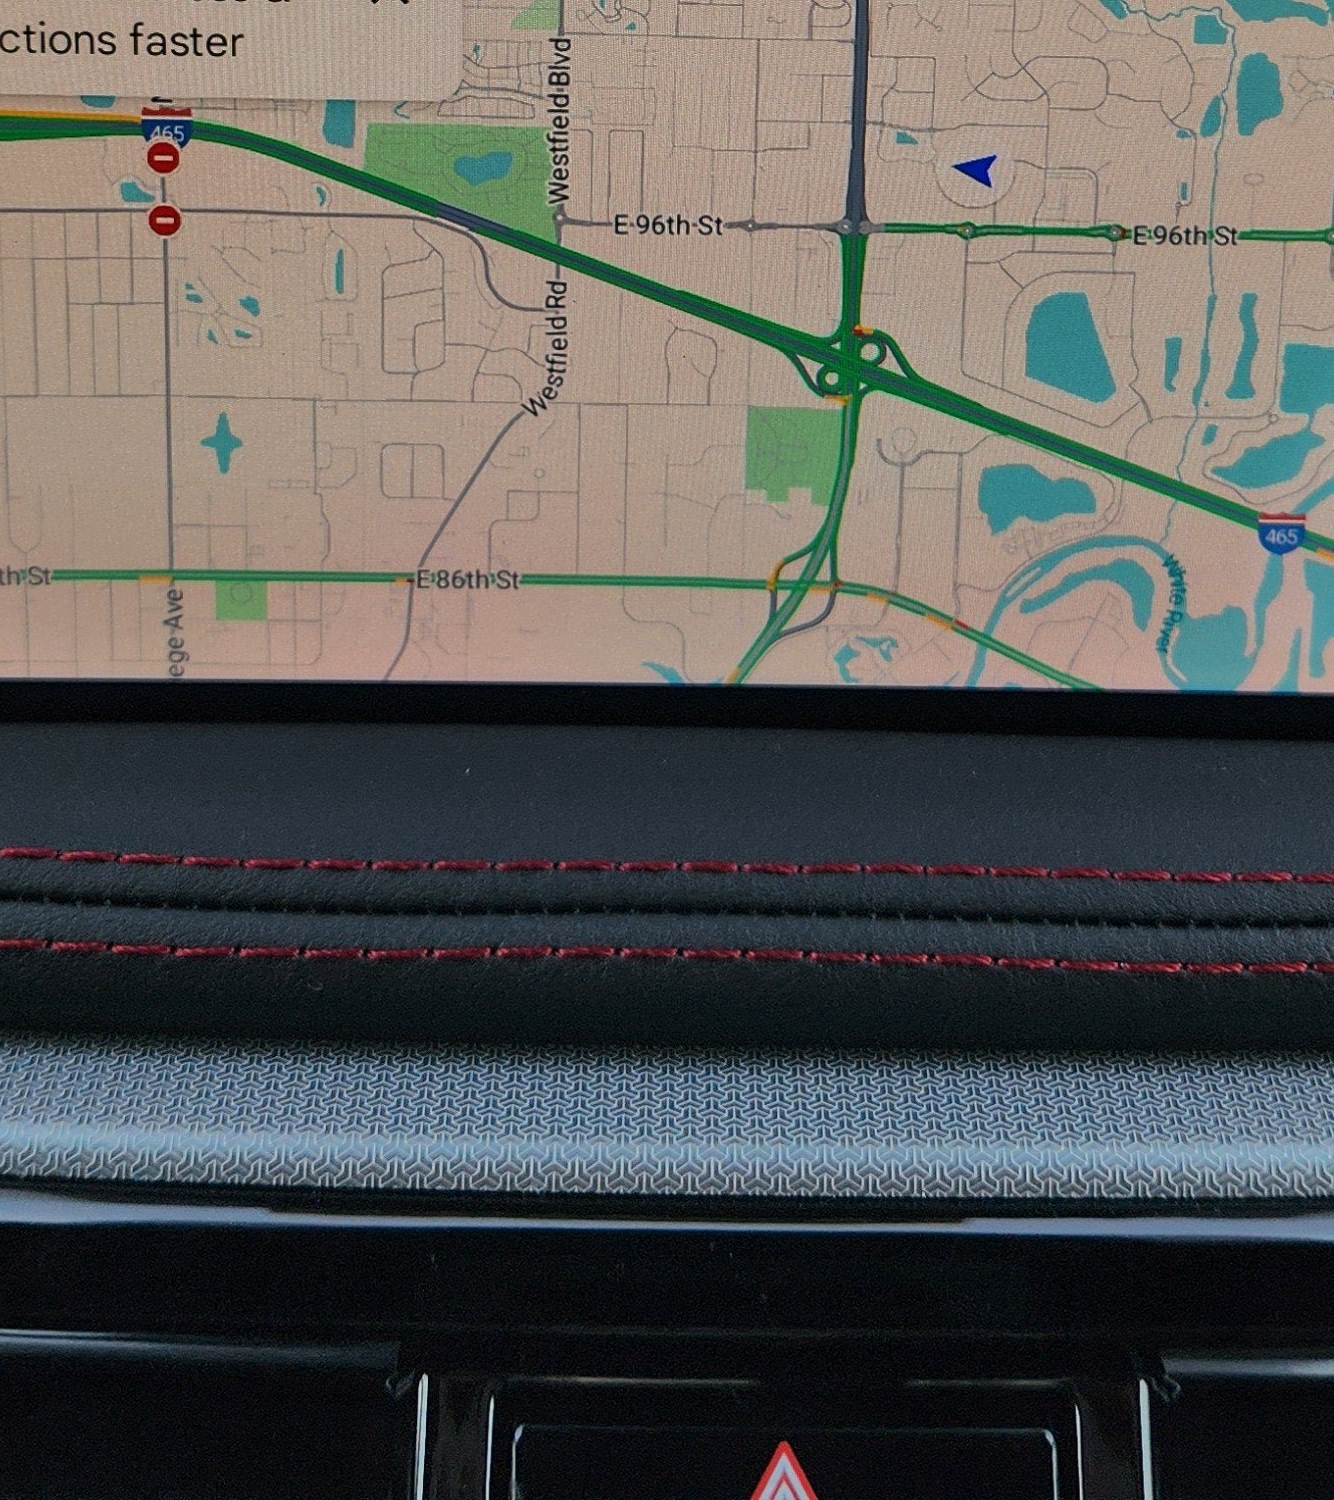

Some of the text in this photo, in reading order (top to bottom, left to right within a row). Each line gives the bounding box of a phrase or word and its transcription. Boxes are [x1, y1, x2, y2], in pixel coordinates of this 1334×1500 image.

[129, 22, 246, 58] faster
[546, 37, 571, 204] Westfield Blvd
[150, 125, 184, 142] 465
[614, 214, 722, 236] E 96th St
[1133, 225, 1237, 246] E 96th St
[520, 280, 568, 417] Westfield Rd
[1265, 528, 1298, 545] 465
[27, 566, 51, 586] St
[417, 569, 519, 590] E 86th St
[163, 588, 184, 630] Ave
